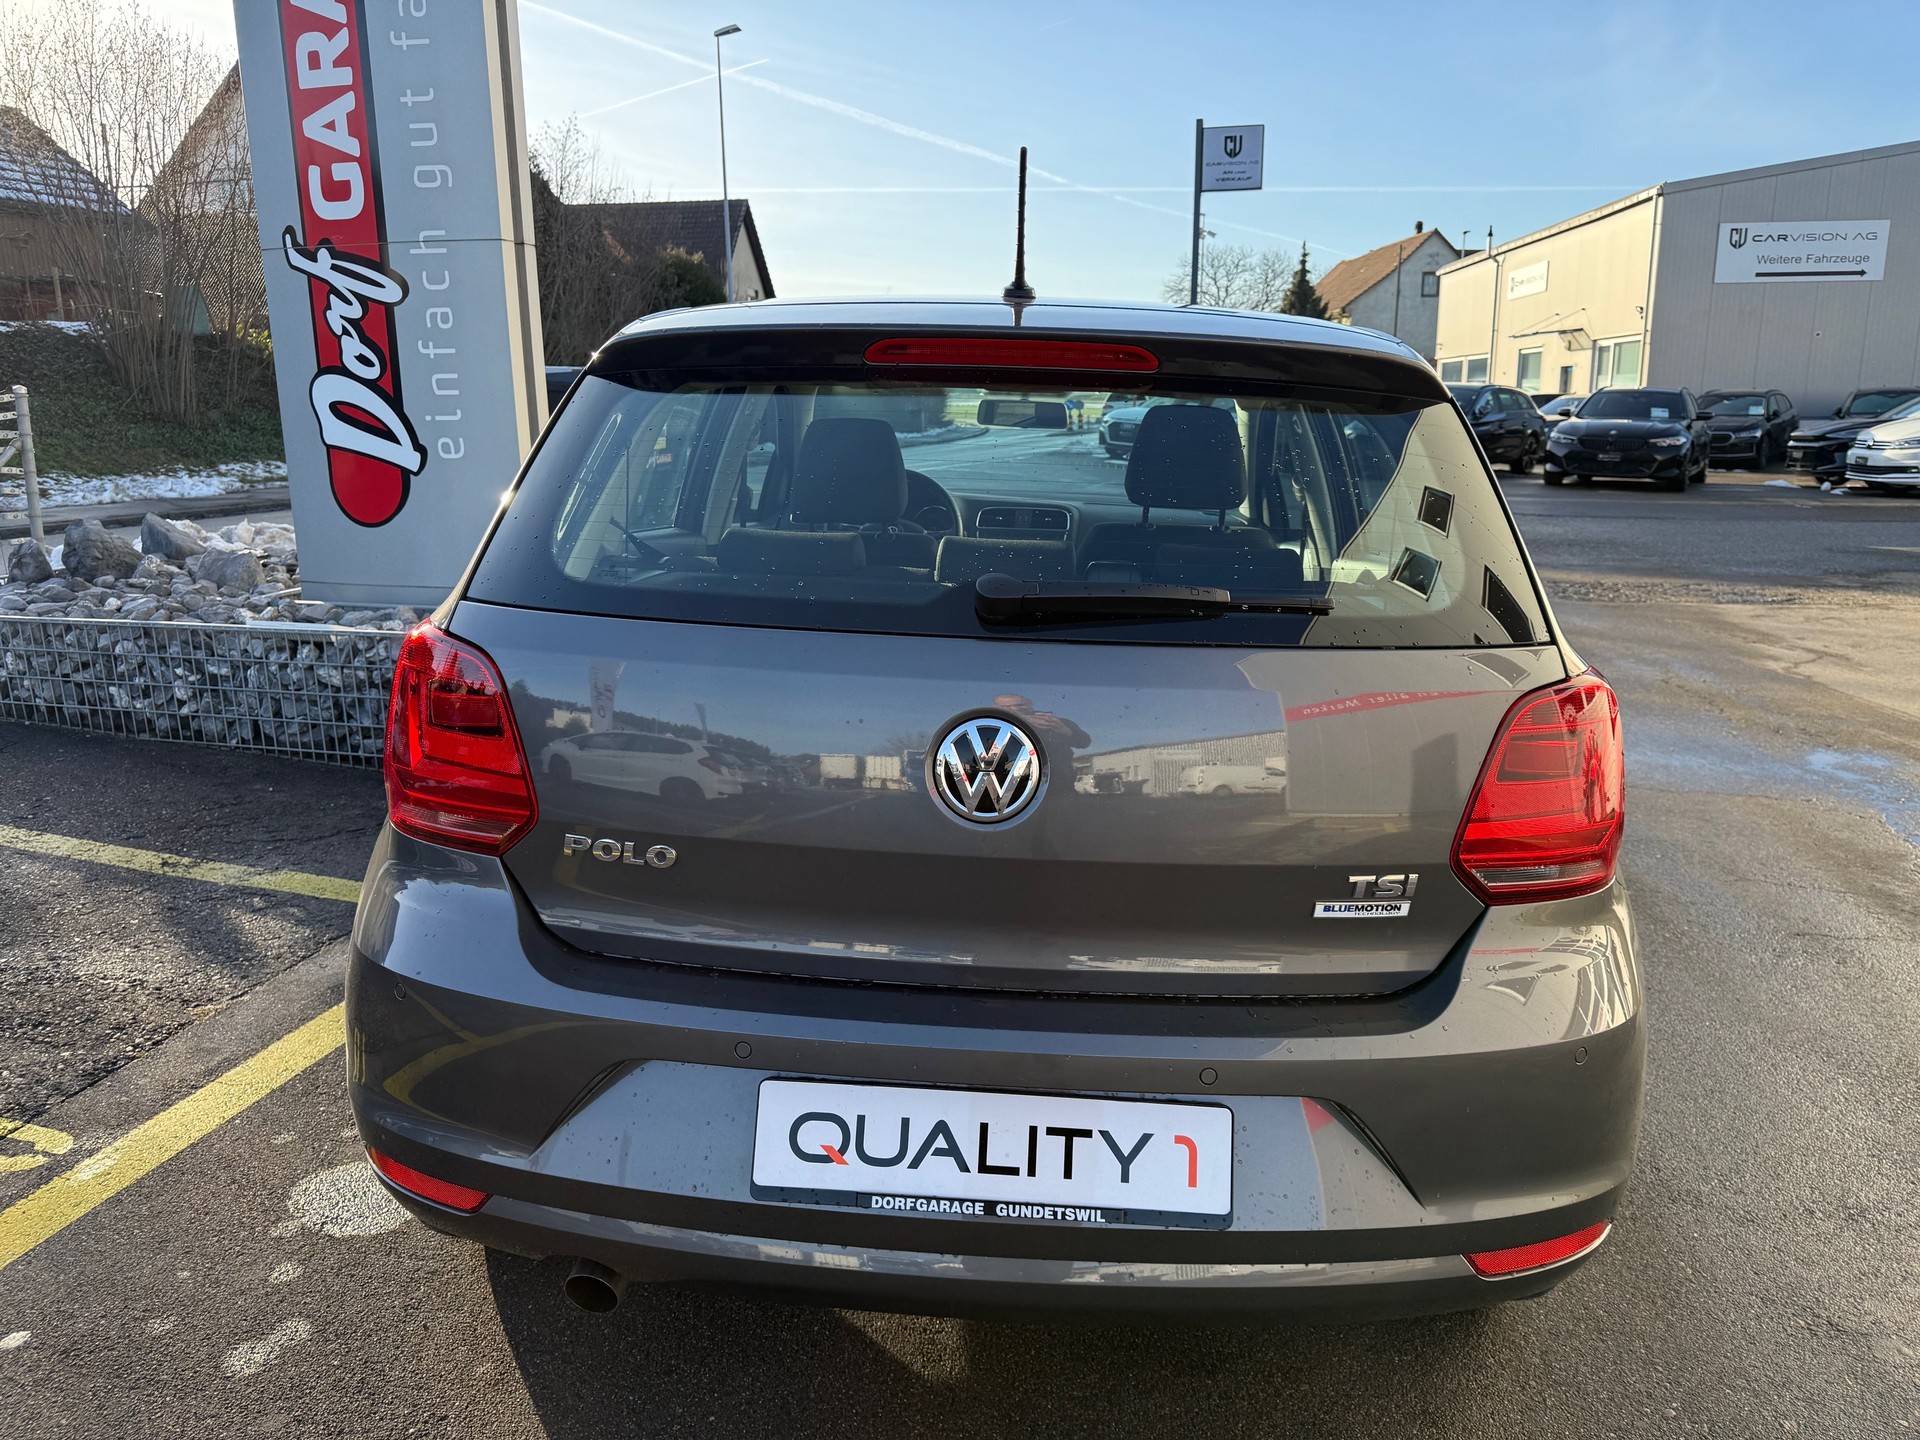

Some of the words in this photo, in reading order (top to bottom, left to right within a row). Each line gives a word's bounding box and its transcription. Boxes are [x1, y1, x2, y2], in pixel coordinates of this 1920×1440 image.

[399, 87, 453, 188] gut
[1752, 232, 1848, 243] CARVISION
[1852, 231, 1878, 242] AG
[1756, 254, 1803, 265] Weitere
[1805, 253, 1871, 266] Fahrzeuge
[285, 233, 422, 474] Dorf
[409, 229, 465, 460] einfach
[563, 833, 678, 869] POLO
[1348, 873, 1419, 899] TSI
[1322, 904, 1402, 912] BLUEMOTION
[788, 1110, 1155, 1185] QUALITY
[870, 1195, 985, 1217] DORFGARAGE
[995, 1203, 1106, 1223] GUNDETSWIL
